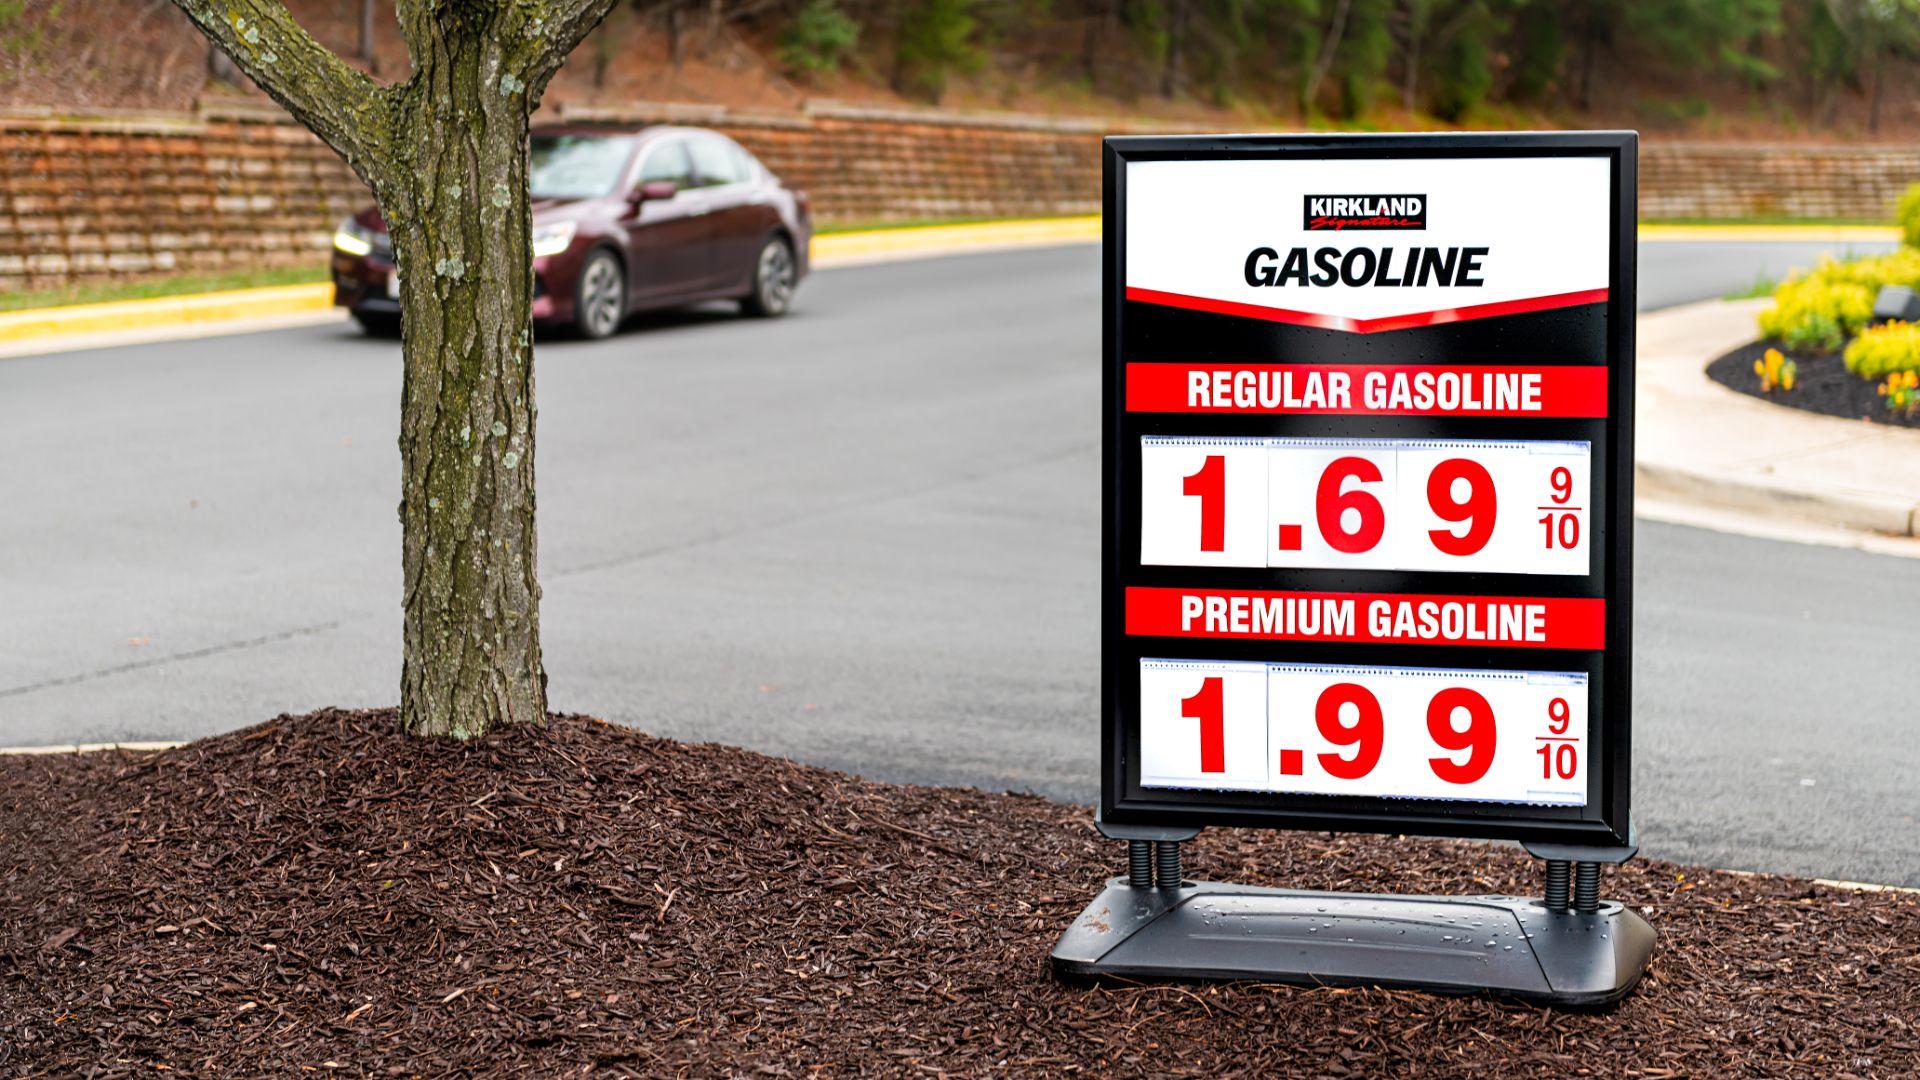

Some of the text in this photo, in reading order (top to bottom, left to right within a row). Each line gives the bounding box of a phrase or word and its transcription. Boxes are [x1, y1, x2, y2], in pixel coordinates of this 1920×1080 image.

[1310, 215, 1422, 231] Signature
[1311, 197, 1422, 217] KIRKLAND
[1244, 246, 1490, 288] GASOLINE
[1187, 370, 1543, 411] REGULAR GASOLINE
[1180, 595, 1547, 642] PREMIUM GASOLINE
